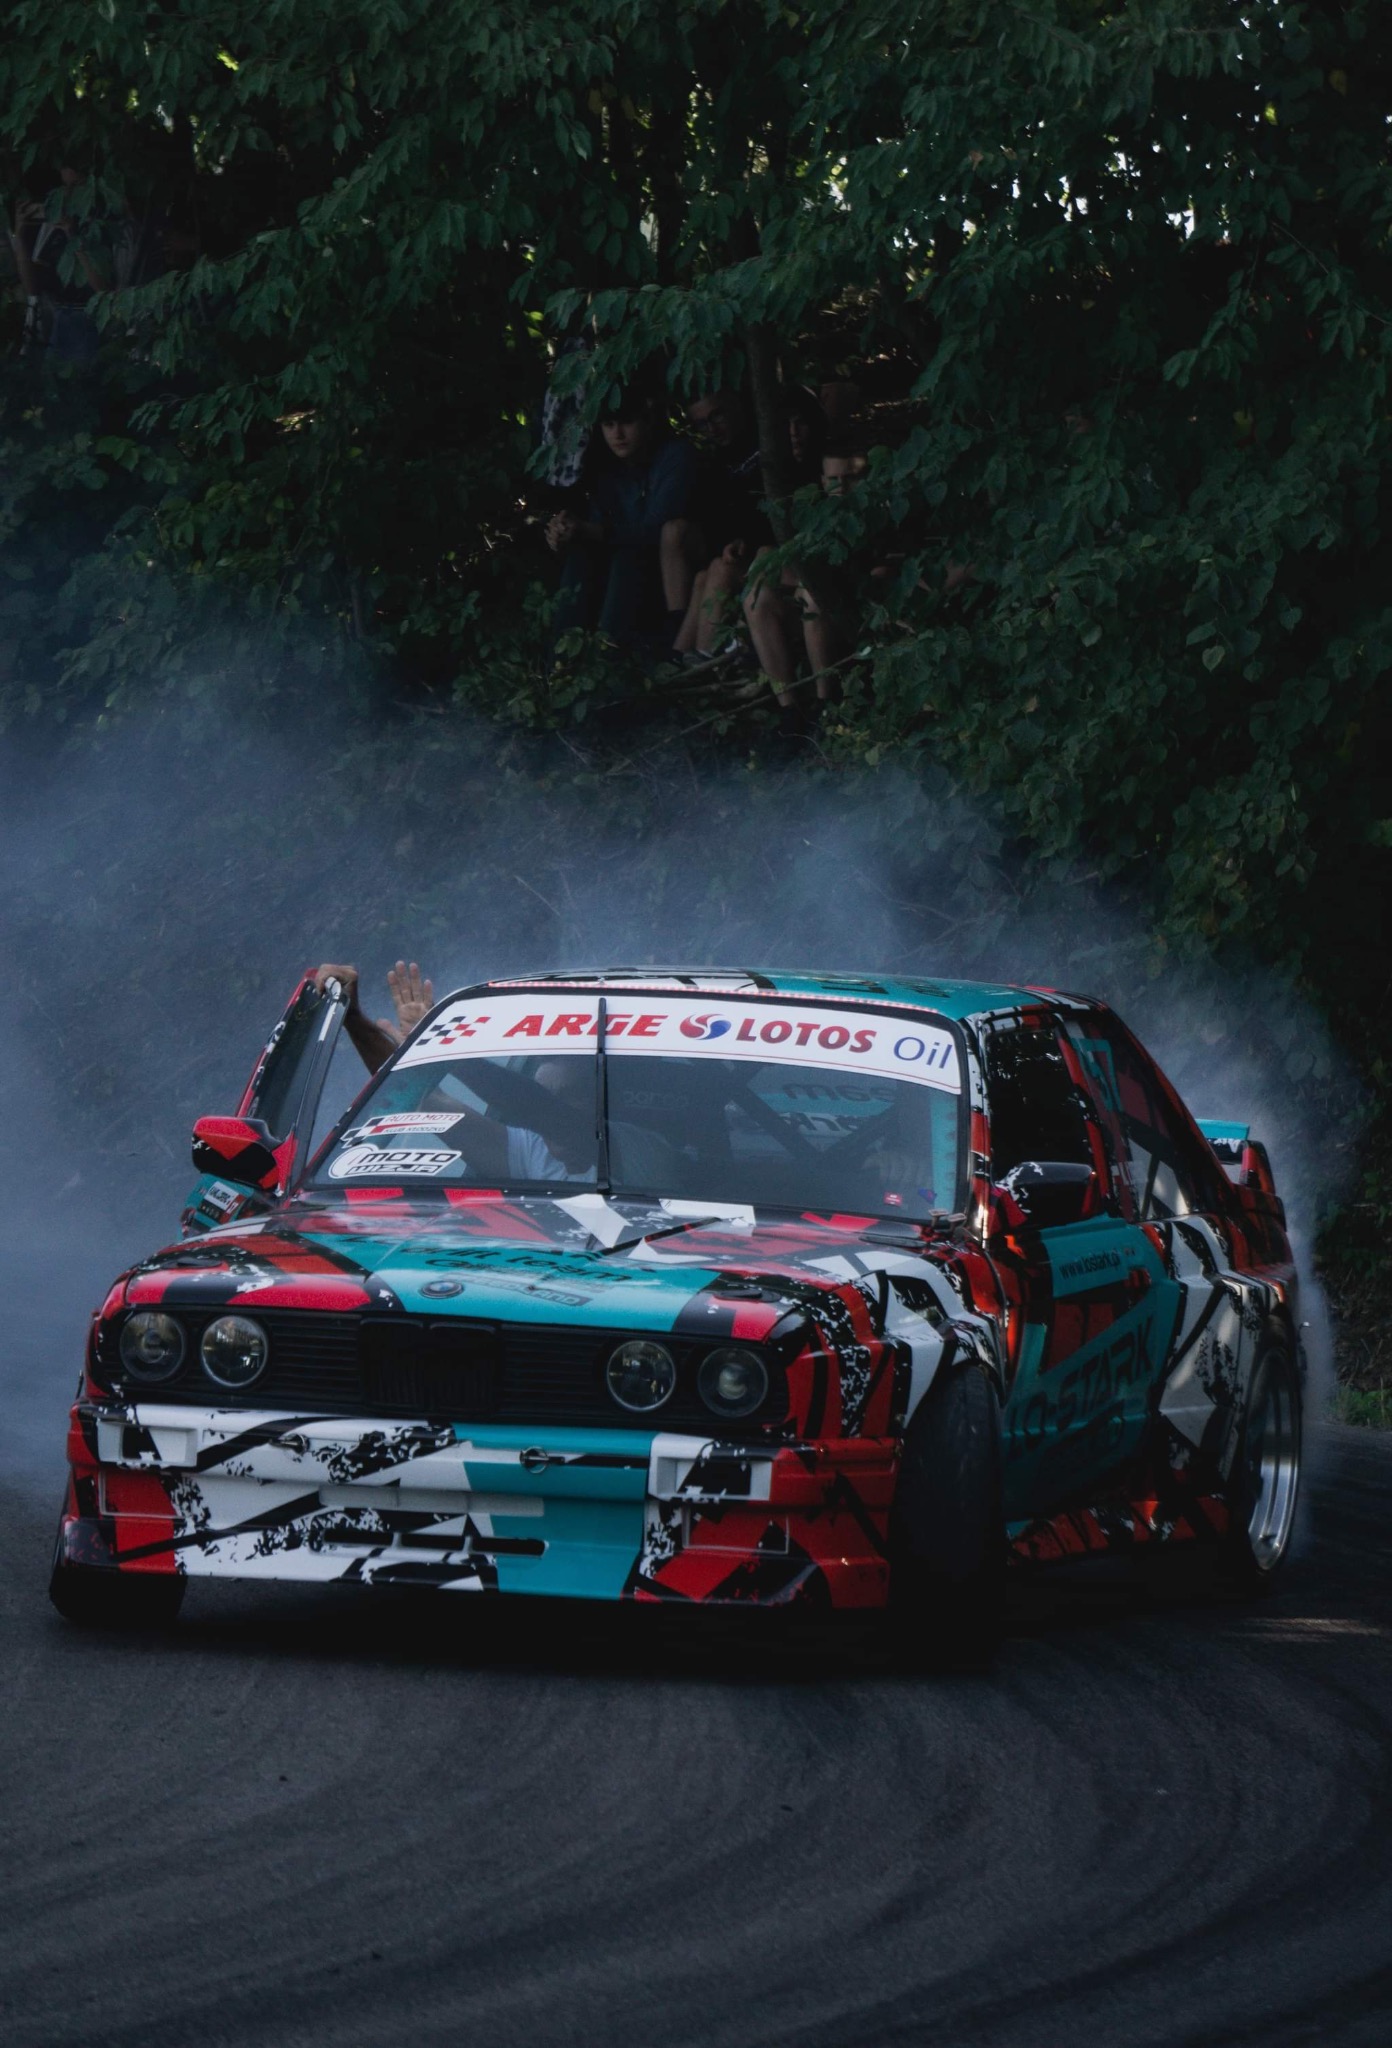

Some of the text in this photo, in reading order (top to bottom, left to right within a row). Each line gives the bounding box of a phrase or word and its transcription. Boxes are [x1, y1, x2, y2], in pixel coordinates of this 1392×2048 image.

[503, 1013, 665, 1038] ARGE
[736, 1017, 953, 1070] LOTOS Oil
[385, 1113, 461, 1123] AUTO MOTO
[358, 1151, 458, 1164] MOTO
[1008, 1313, 1154, 1458] LO-STARK
